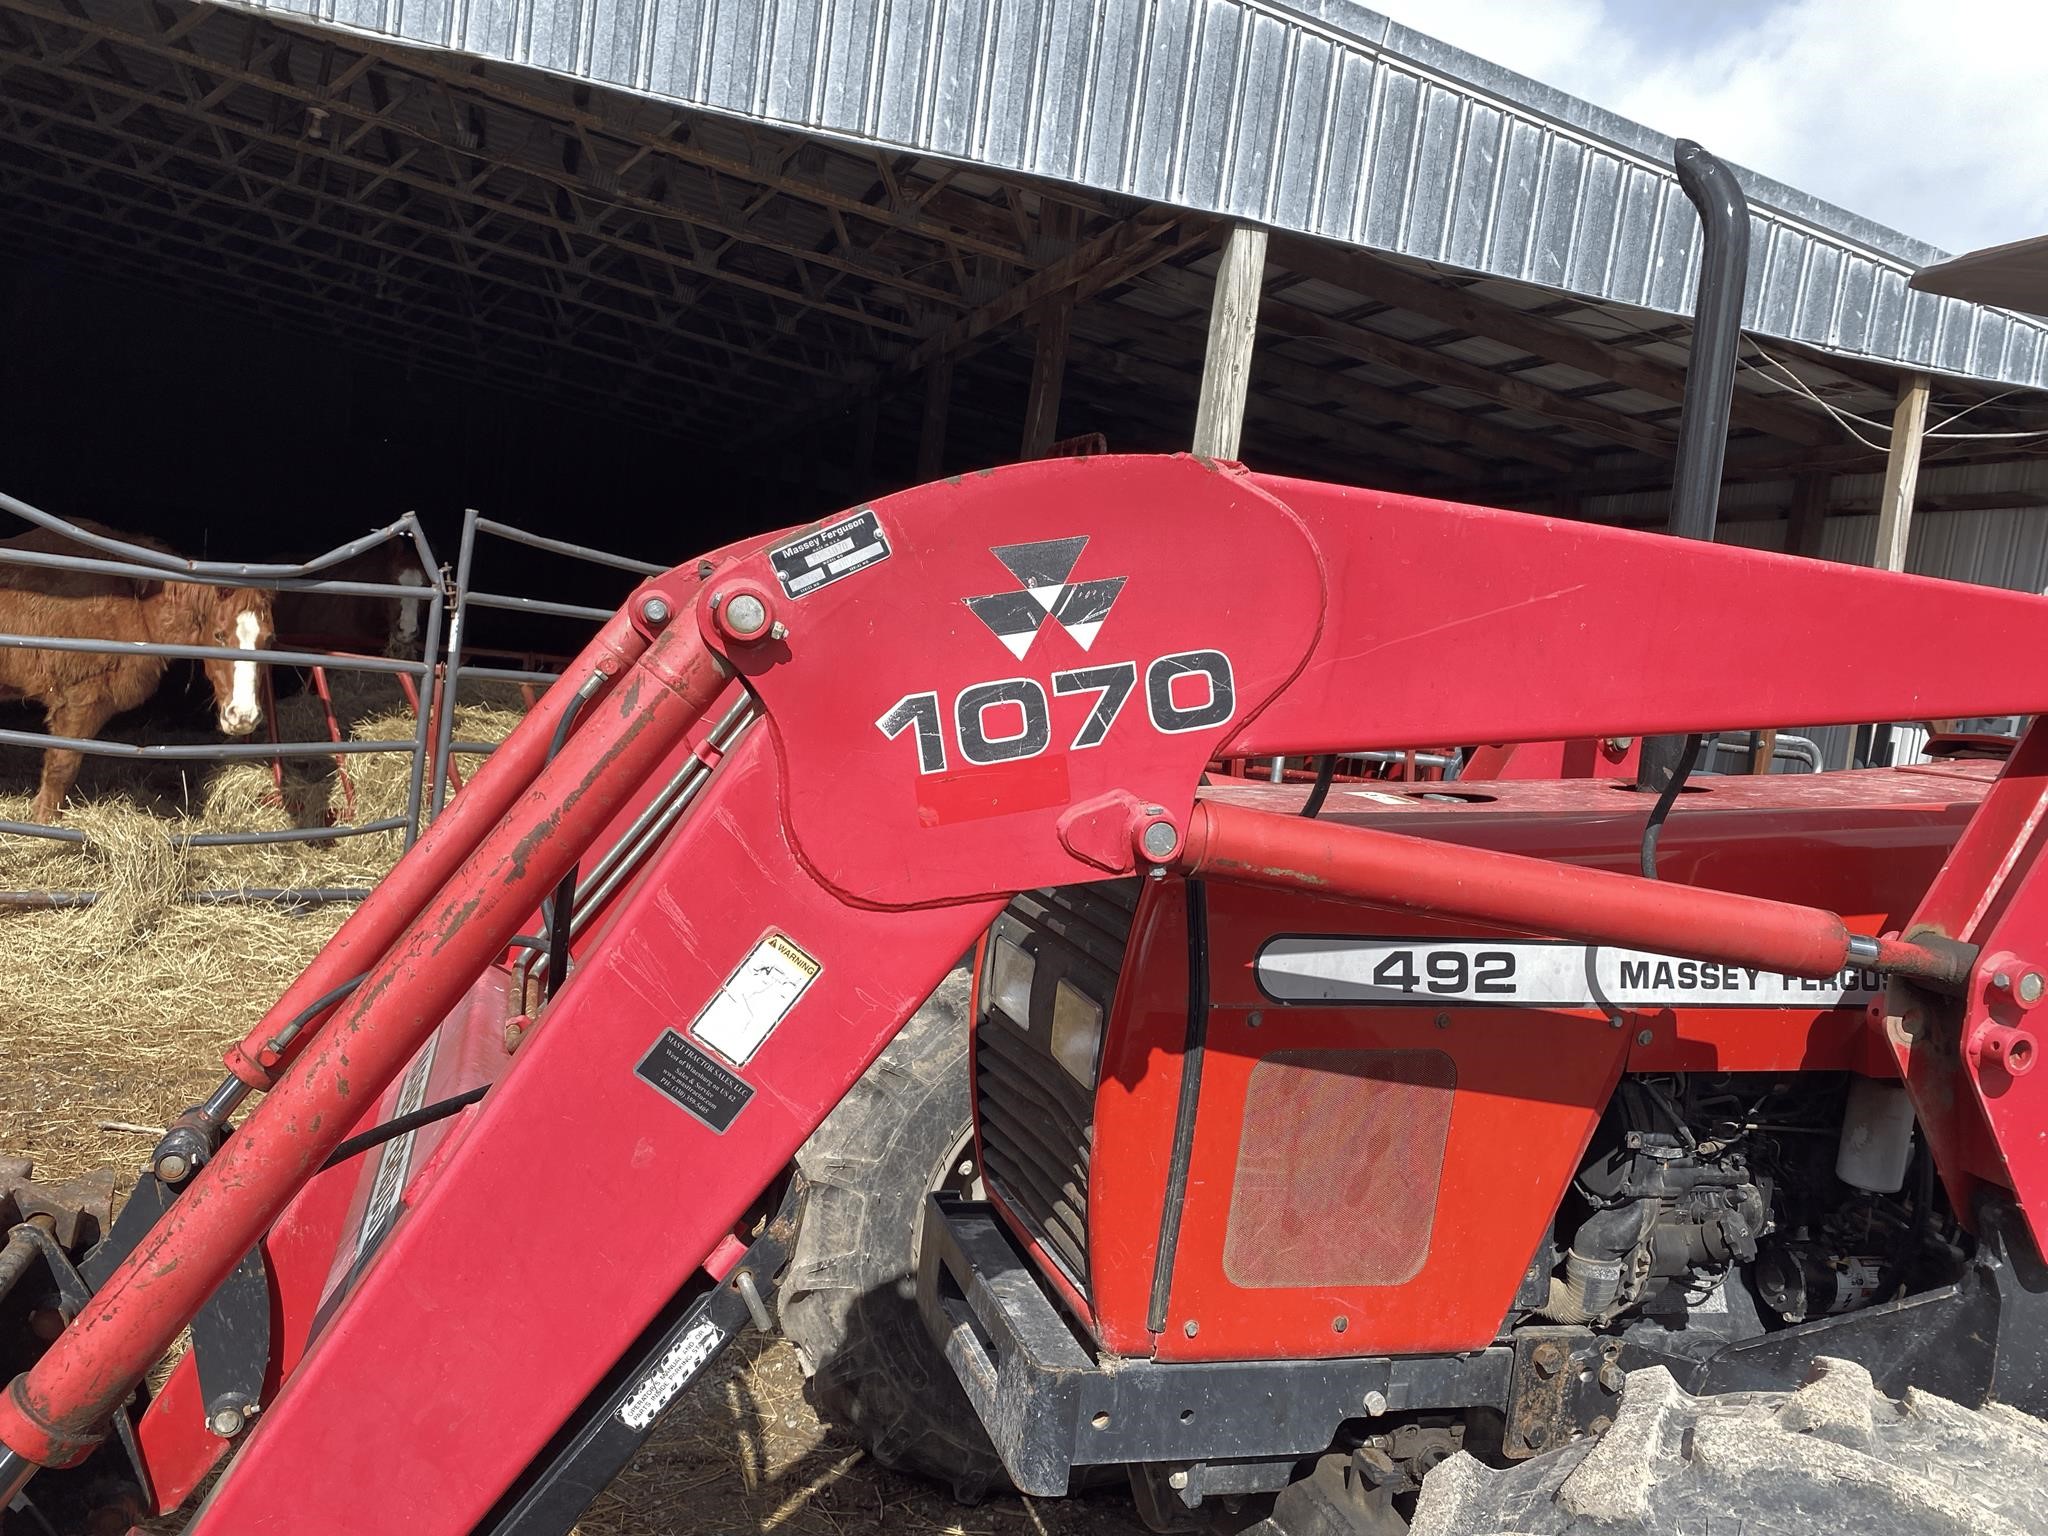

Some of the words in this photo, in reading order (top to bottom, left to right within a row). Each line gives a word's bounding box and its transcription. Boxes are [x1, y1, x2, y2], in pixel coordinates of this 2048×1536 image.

[782, 538, 820, 559] Massey
[820, 518, 865, 542] Ferguson
[875, 648, 1236, 775] 1070
[777, 943, 815, 976] WARNING
[1373, 951, 1517, 993] 492
[1620, 961, 1759, 990] MASSEY
[666, 1049, 679, 1062] West
[678, 1058, 686, 1066] of
[712, 1084, 720, 1092] on
[728, 1093, 737, 1103] 62
[667, 1035, 684, 1051] MAST
[684, 1047, 715, 1072] TRACTOR
[713, 1069, 734, 1089] SALES,
[674, 1067, 689, 1081] Sales
[695, 1081, 715, 1099] Service
[659, 1357, 682, 1380] MANUAL
[682, 1341, 695, 1355] AND
[694, 1330, 704, 1341] OR
[632, 1402, 652, 1422] PARTS
[650, 1381, 670, 1402] INSIDE
[668, 1354, 693, 1381] PARKING
